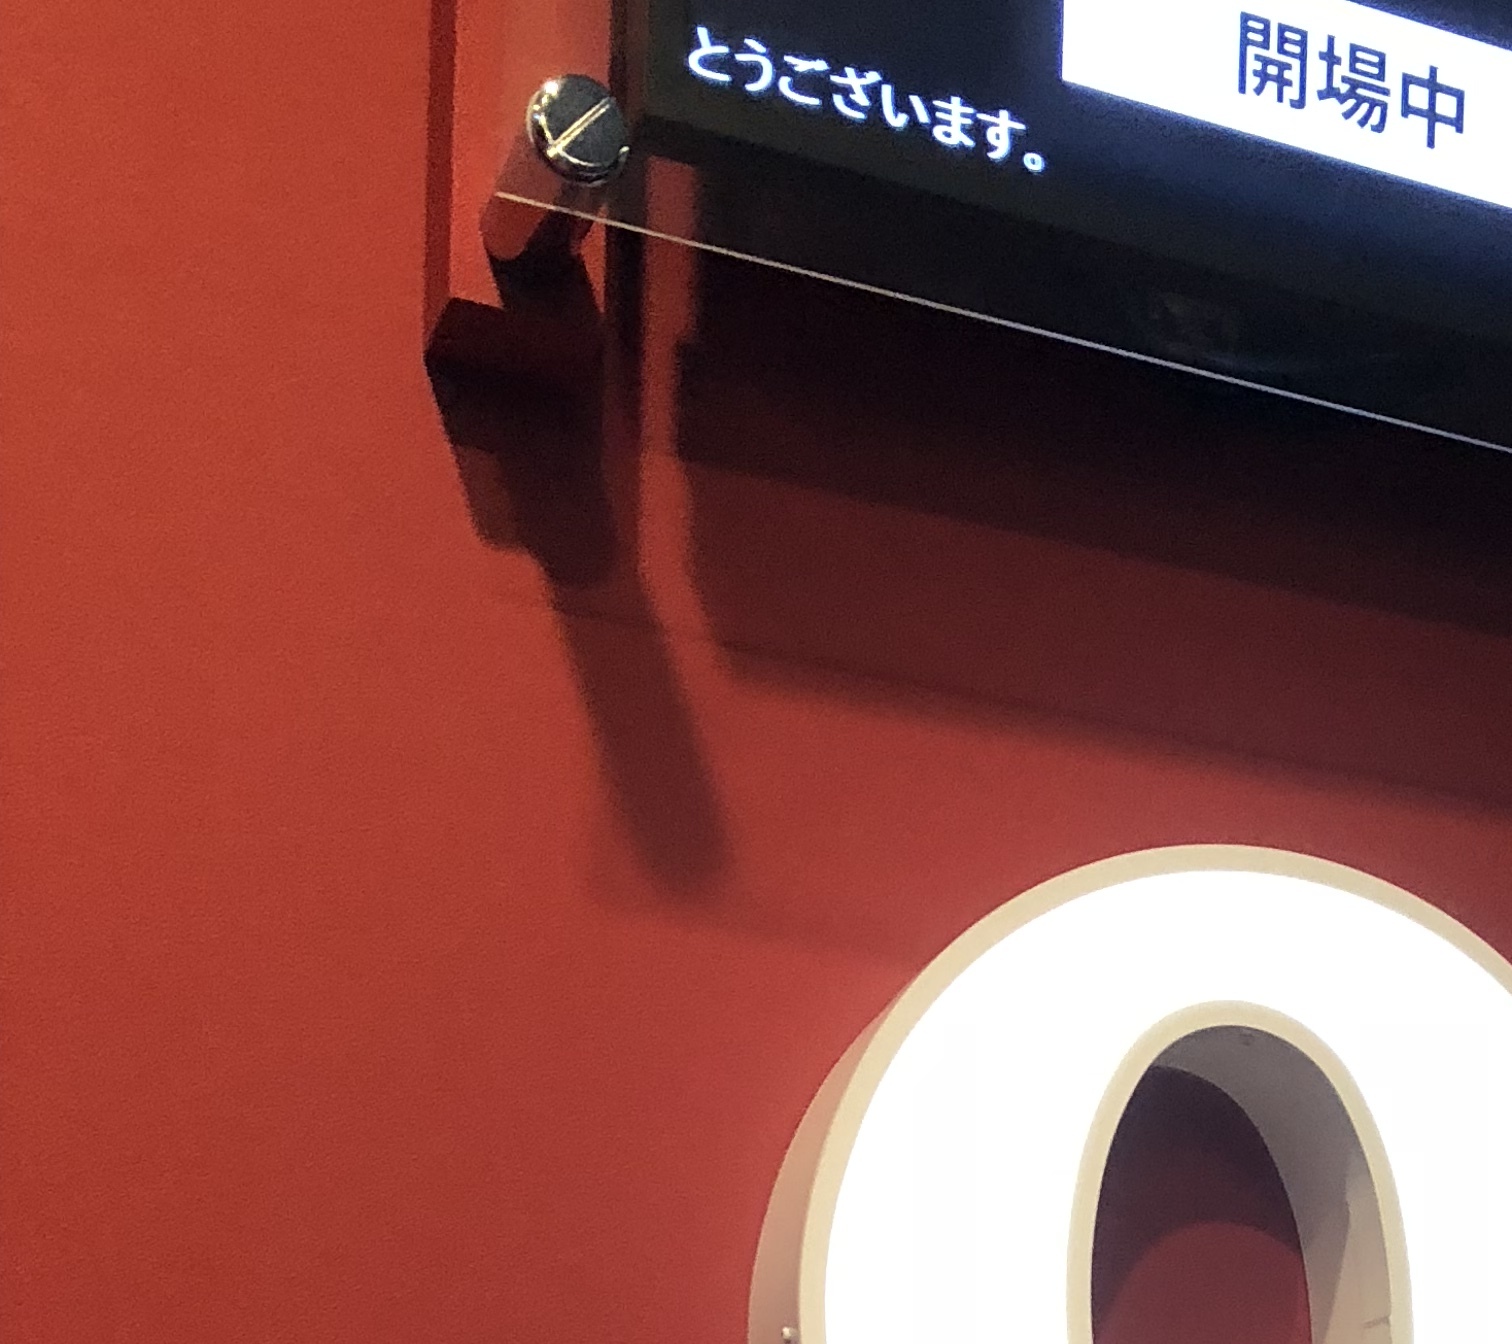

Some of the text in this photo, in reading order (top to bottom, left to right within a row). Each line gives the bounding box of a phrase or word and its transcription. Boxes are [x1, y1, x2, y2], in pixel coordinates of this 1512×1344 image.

[687, 25, 1046, 173] とうございます。
[1237, 10, 1466, 150] 開場中
